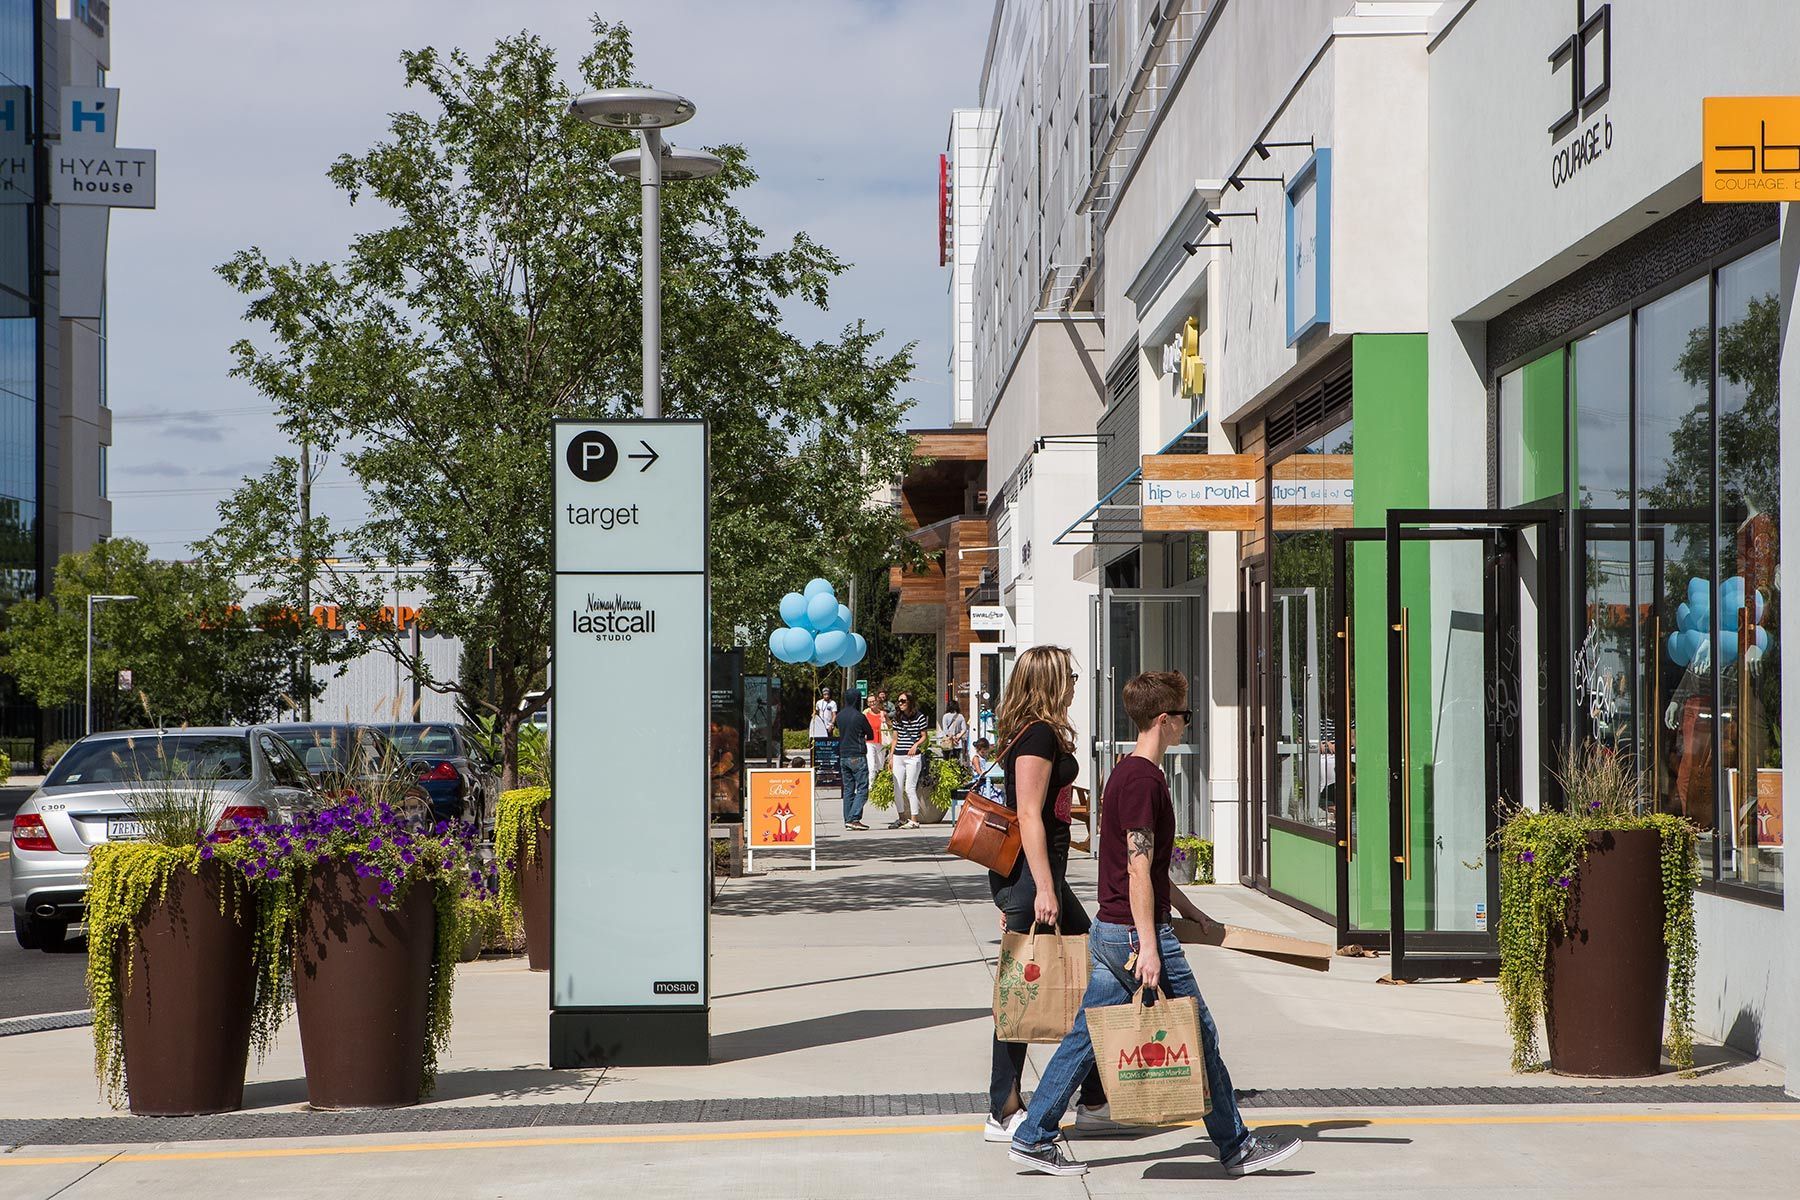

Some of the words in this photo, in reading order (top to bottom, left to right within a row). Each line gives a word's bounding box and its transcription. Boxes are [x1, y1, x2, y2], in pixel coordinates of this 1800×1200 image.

[1604, 113, 1612, 150] b
[60, 158, 146, 177] HYATT
[73, 178, 133, 193] house
[1714, 178, 1788, 190] COURAGE.
[582, 441, 605, 471] P
[1148, 483, 1172, 503] hip
[1176, 490, 1187, 499] to
[1190, 489, 1201, 499] be
[1204, 482, 1250, 500] round
[566, 503, 639, 530] target
[656, 983, 696, 992] mosaic
[1141, 1069, 1165, 1080] Organic
[1165, 1067, 1190, 1077] Market
